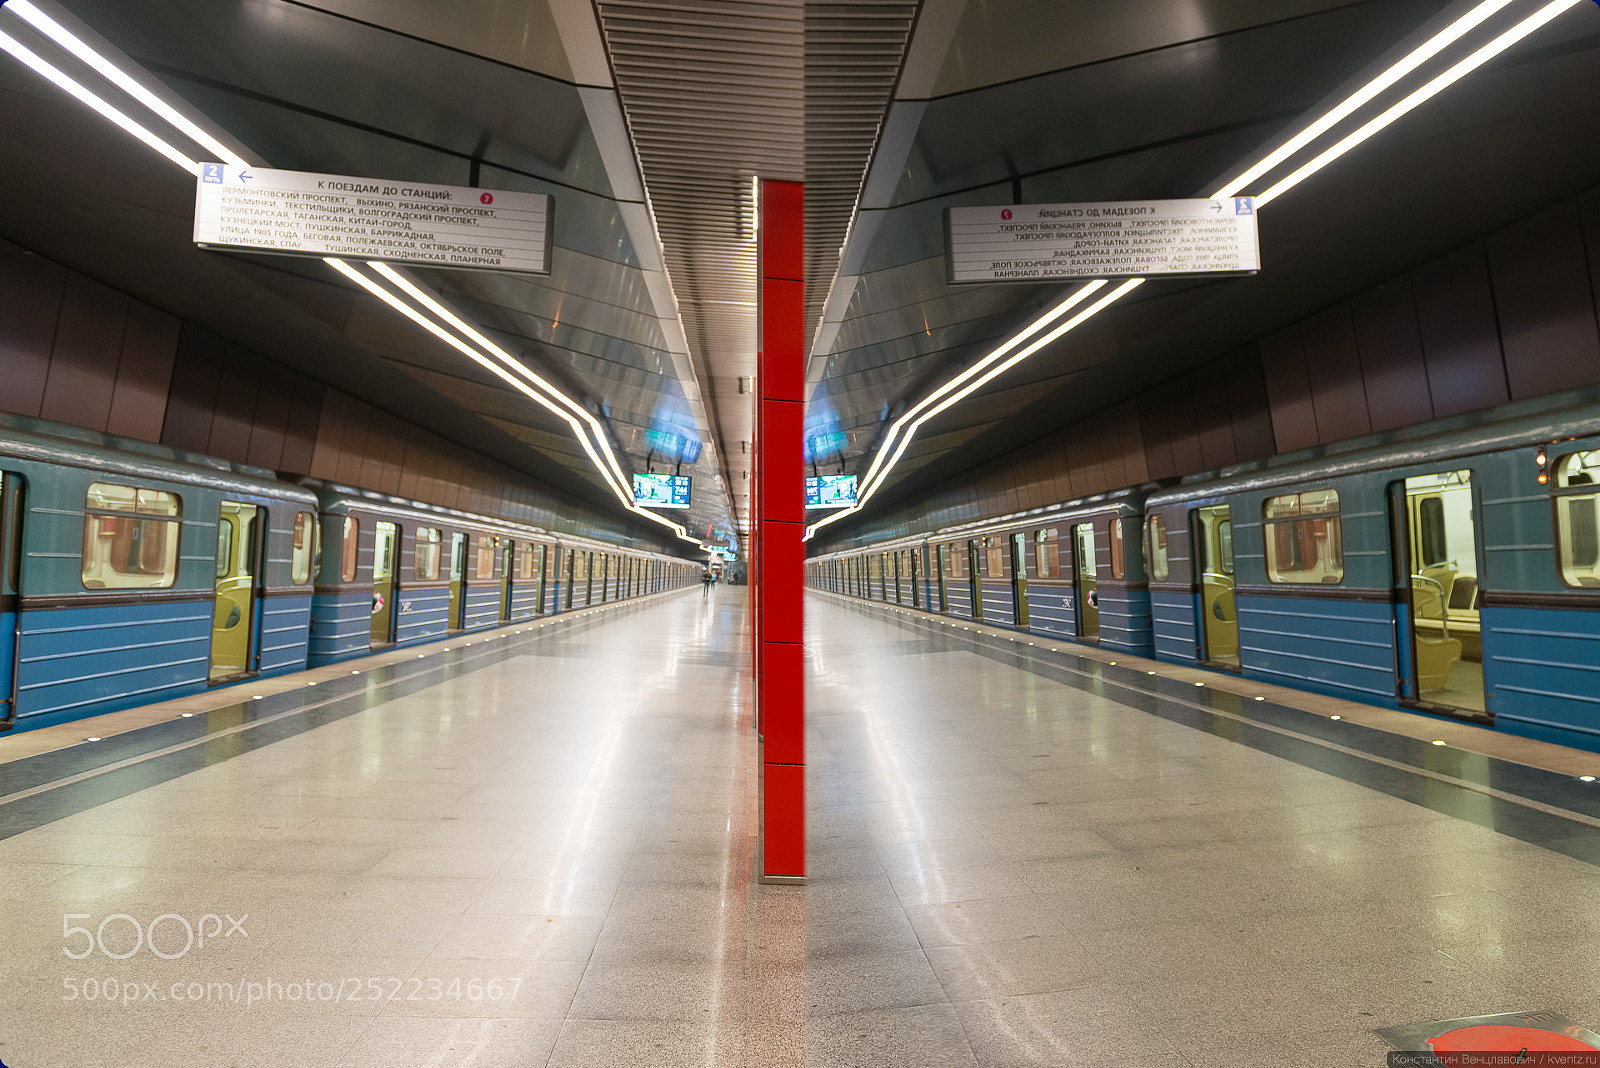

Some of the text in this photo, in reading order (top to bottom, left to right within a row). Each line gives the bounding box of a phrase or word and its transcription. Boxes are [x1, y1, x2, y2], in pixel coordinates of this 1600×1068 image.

[208, 165, 218, 177] 2
[318, 180, 453, 200] К ПОЕЗДАМ ДО СТАНЦИЙ:
[222, 186, 497, 218] ЛЕРМОНТОВСКИЙ ПРОСПЕКТ, ВЫХИНО, РЯЗАНСКИЙ ПРОСПЕКТ,
[222, 197, 480, 226] КУЗЬМИНКИ, ТЕКСТИЛЬЩИКИ, ВОЛГОГРАДСКИЙ ПРОСПЕКТ,
[220, 206, 290, 219] ПРОЛЕТАРСКАЯ,
[294, 212, 346, 224] ТАГАНСКАЯ,
[220, 216, 436, 241] КУЗНЕЦКИЙ МОСТ, ПУШКИНСКАЯ, БАРРИКАДНАЯ,
[219, 226, 506, 258] УЛИЦА 1905 ГОДА, БЕГОВАЯ, ПОЛЕЖАЕВСКАЯ, ОКТЯБРЬСКОЕ ПОЛЕ,
[325, 244, 381, 256] ТУШИНСКАЯ,
[383, 249, 448, 262] СХОДНЕНСКАЯ,
[450, 254, 501, 266] ПЛАНЕРНАЯ
